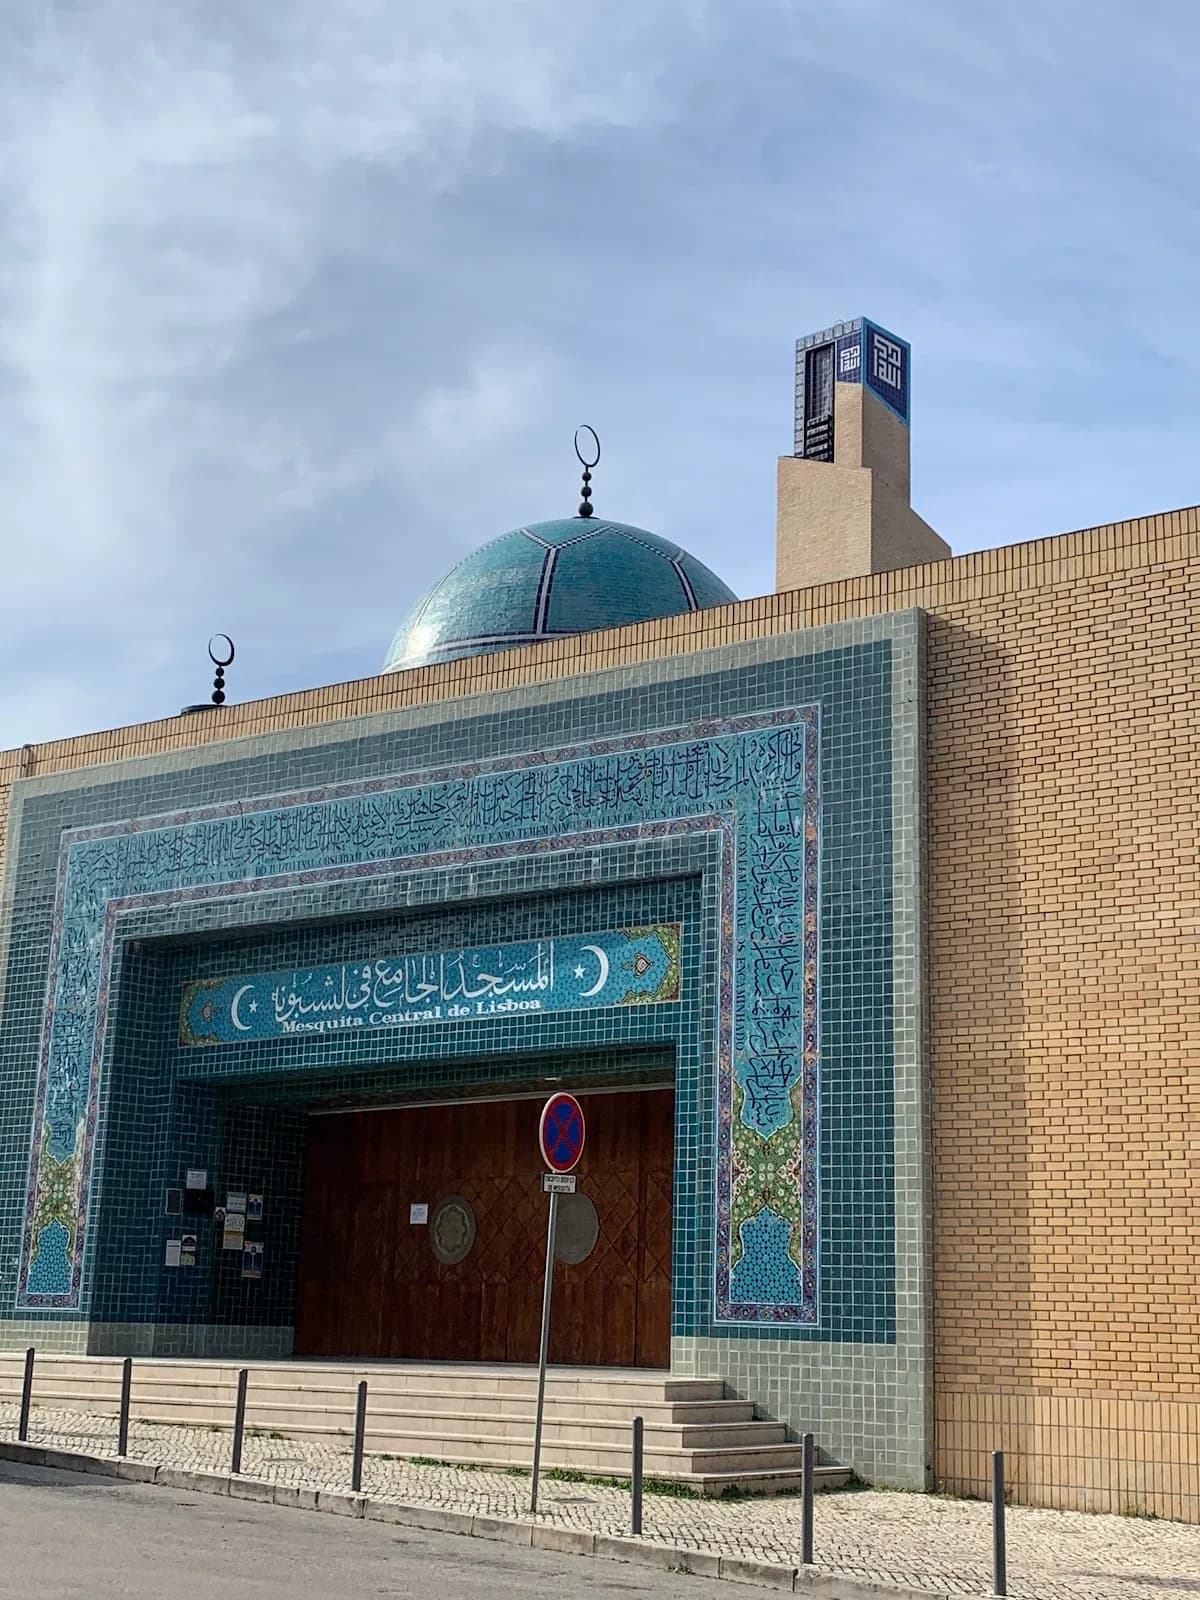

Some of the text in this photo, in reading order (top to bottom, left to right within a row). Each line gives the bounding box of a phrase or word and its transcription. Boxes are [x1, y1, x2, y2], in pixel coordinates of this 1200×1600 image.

[282, 999, 542, 1033] Mesquita Central de Lisboa
